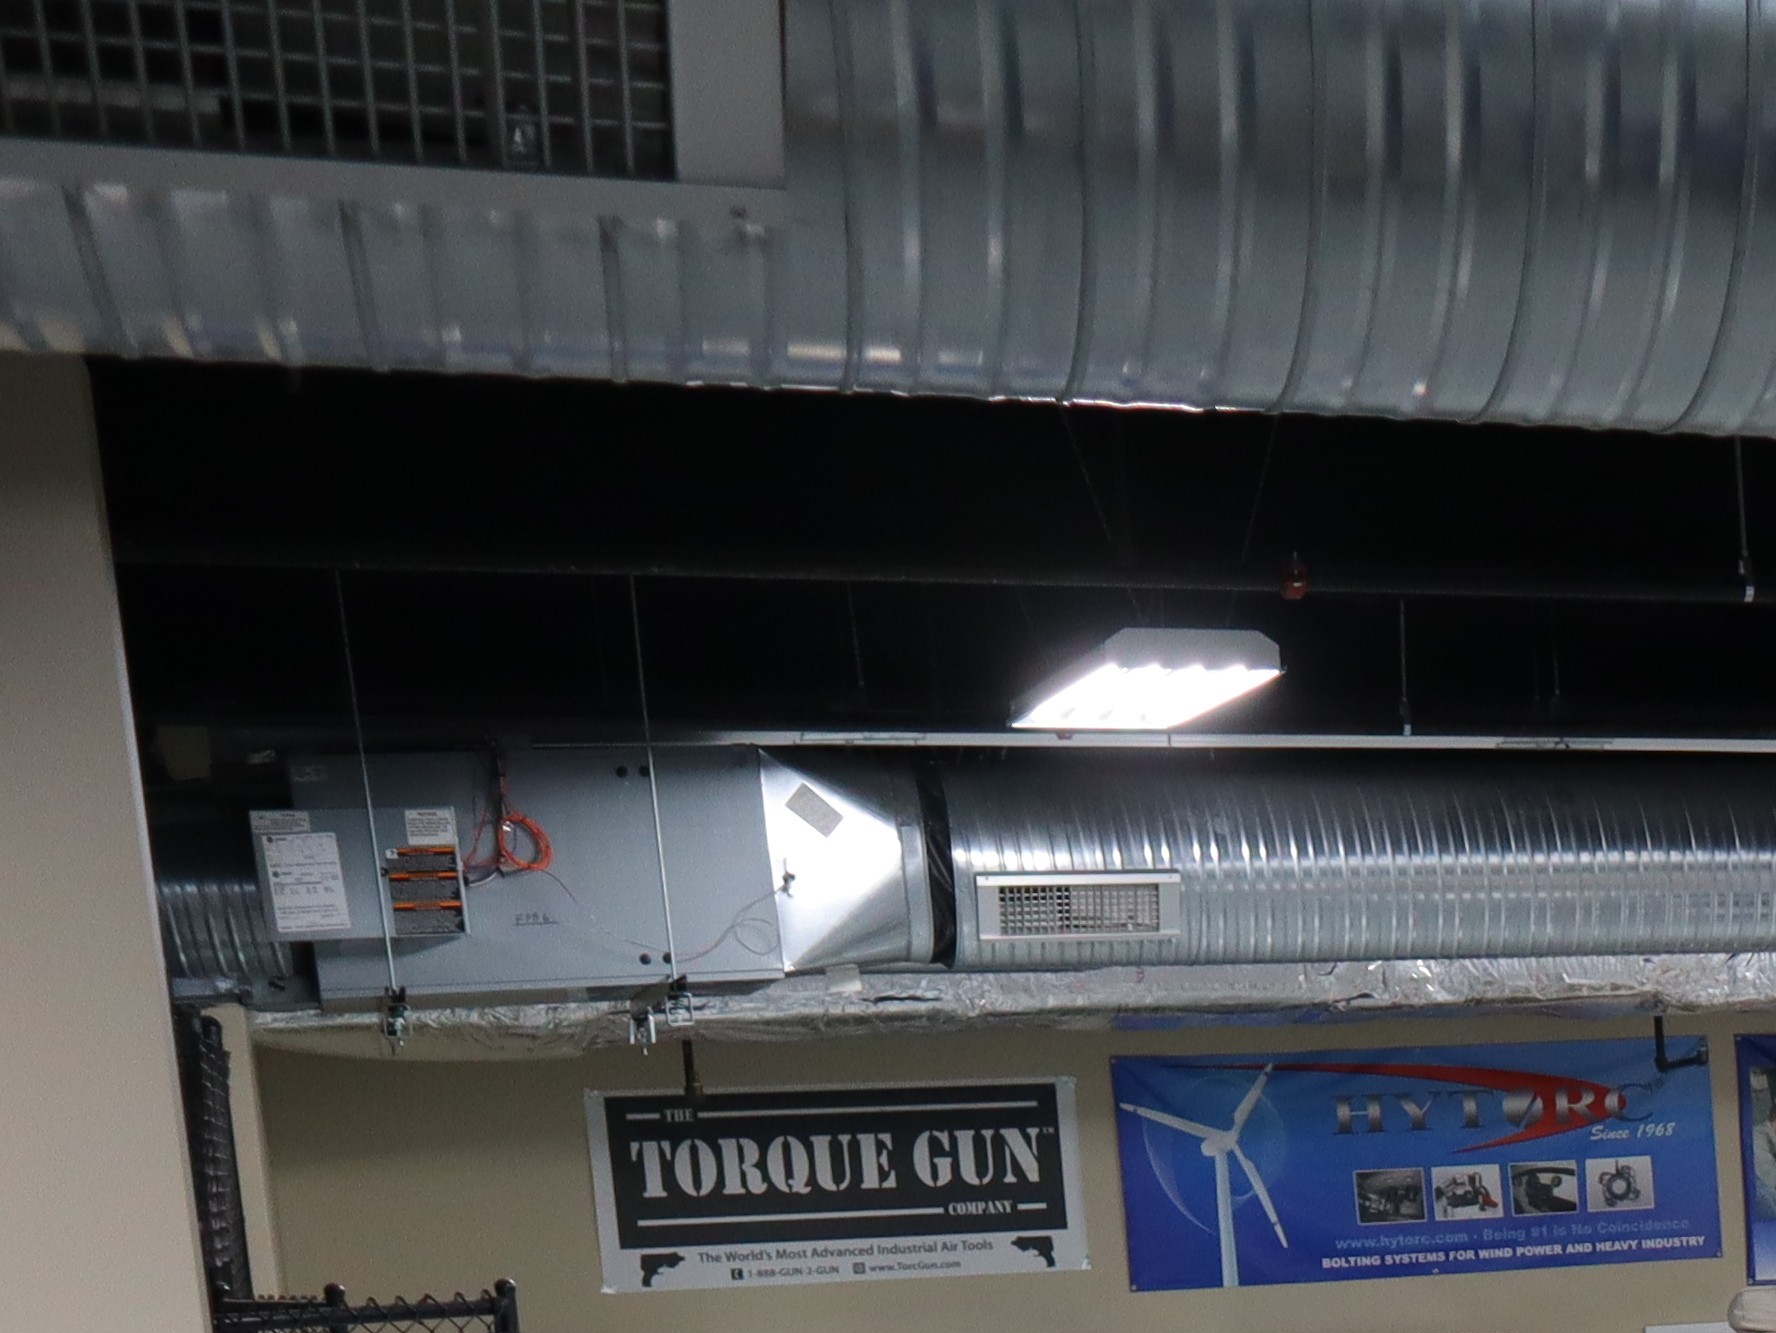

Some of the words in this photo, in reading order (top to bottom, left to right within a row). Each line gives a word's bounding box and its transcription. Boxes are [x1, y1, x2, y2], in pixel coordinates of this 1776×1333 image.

[663, 1109, 694, 1122] THE
[1333, 1082, 1655, 1135] HYTORC
[1590, 1125, 1630, 1141] Since
[1636, 1121, 1676, 1138] 1968
[629, 1132, 897, 1198] TORQUE
[912, 1127, 1041, 1188] GUN
[947, 1200, 1014, 1216] COMPANY
[698, 1251, 722, 1264] The
[724, 1250, 773, 1263] World's
[775, 1248, 807, 1260] Most
[811, 1244, 874, 1258] Advanced
[877, 1241, 938, 1256] Industrial
[941, 1240, 958, 1252] Air
[961, 1238, 994, 1251] Tools
[1321, 1255, 1381, 1269] BOLTING
[1384, 1251, 1446, 1265] SYSTEMS
[1449, 1250, 1475, 1261] FOR
[1479, 1247, 1513, 1260] WIND
[1516, 1243, 1563, 1257] POWER
[1566, 1242, 1592, 1254] AND
[1595, 1239, 1638, 1252] HEAVY
[1641, 1235, 1705, 1249] INDUSTRY
